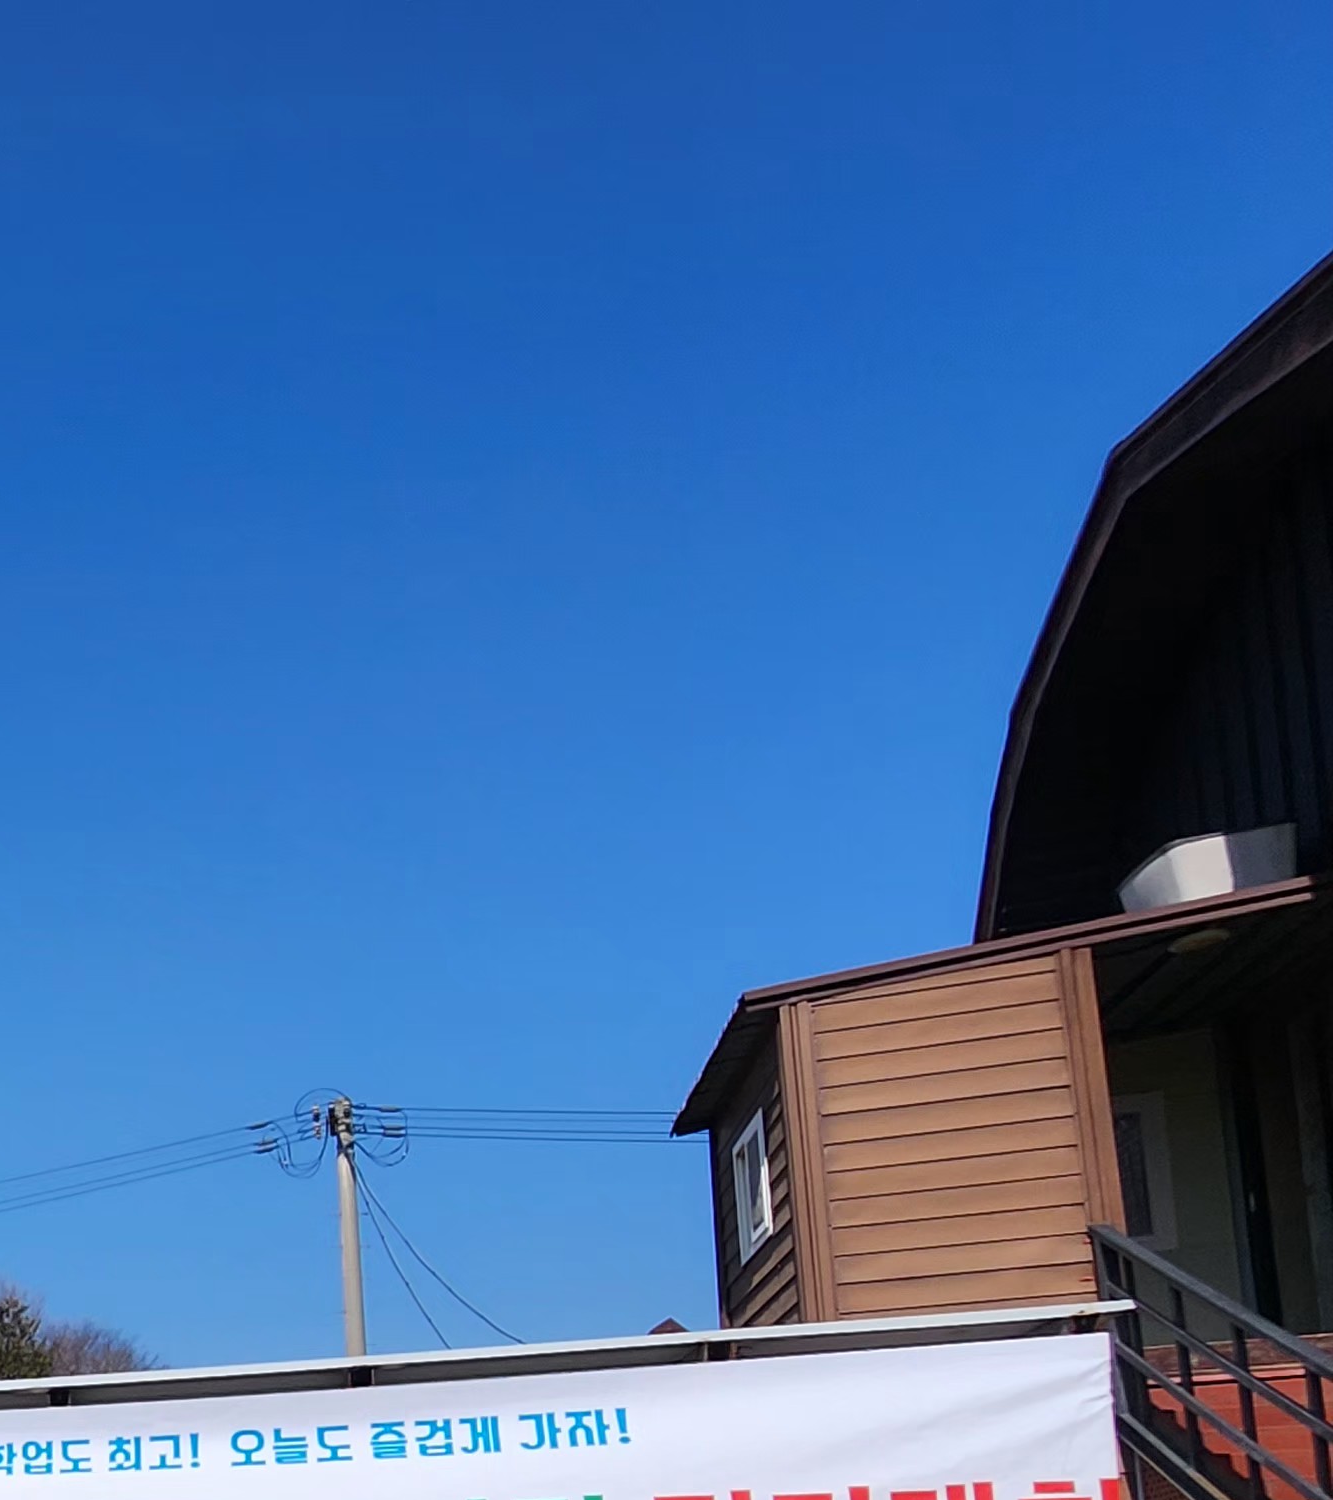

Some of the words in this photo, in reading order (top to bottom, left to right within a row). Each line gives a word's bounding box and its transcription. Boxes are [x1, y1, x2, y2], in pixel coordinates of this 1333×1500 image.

[107, 1432, 201, 1473] 최고!
[229, 1424, 353, 1467] 오늘도
[369, 1415, 502, 1460] 즐겁게
[517, 1407, 632, 1451] 가자!
